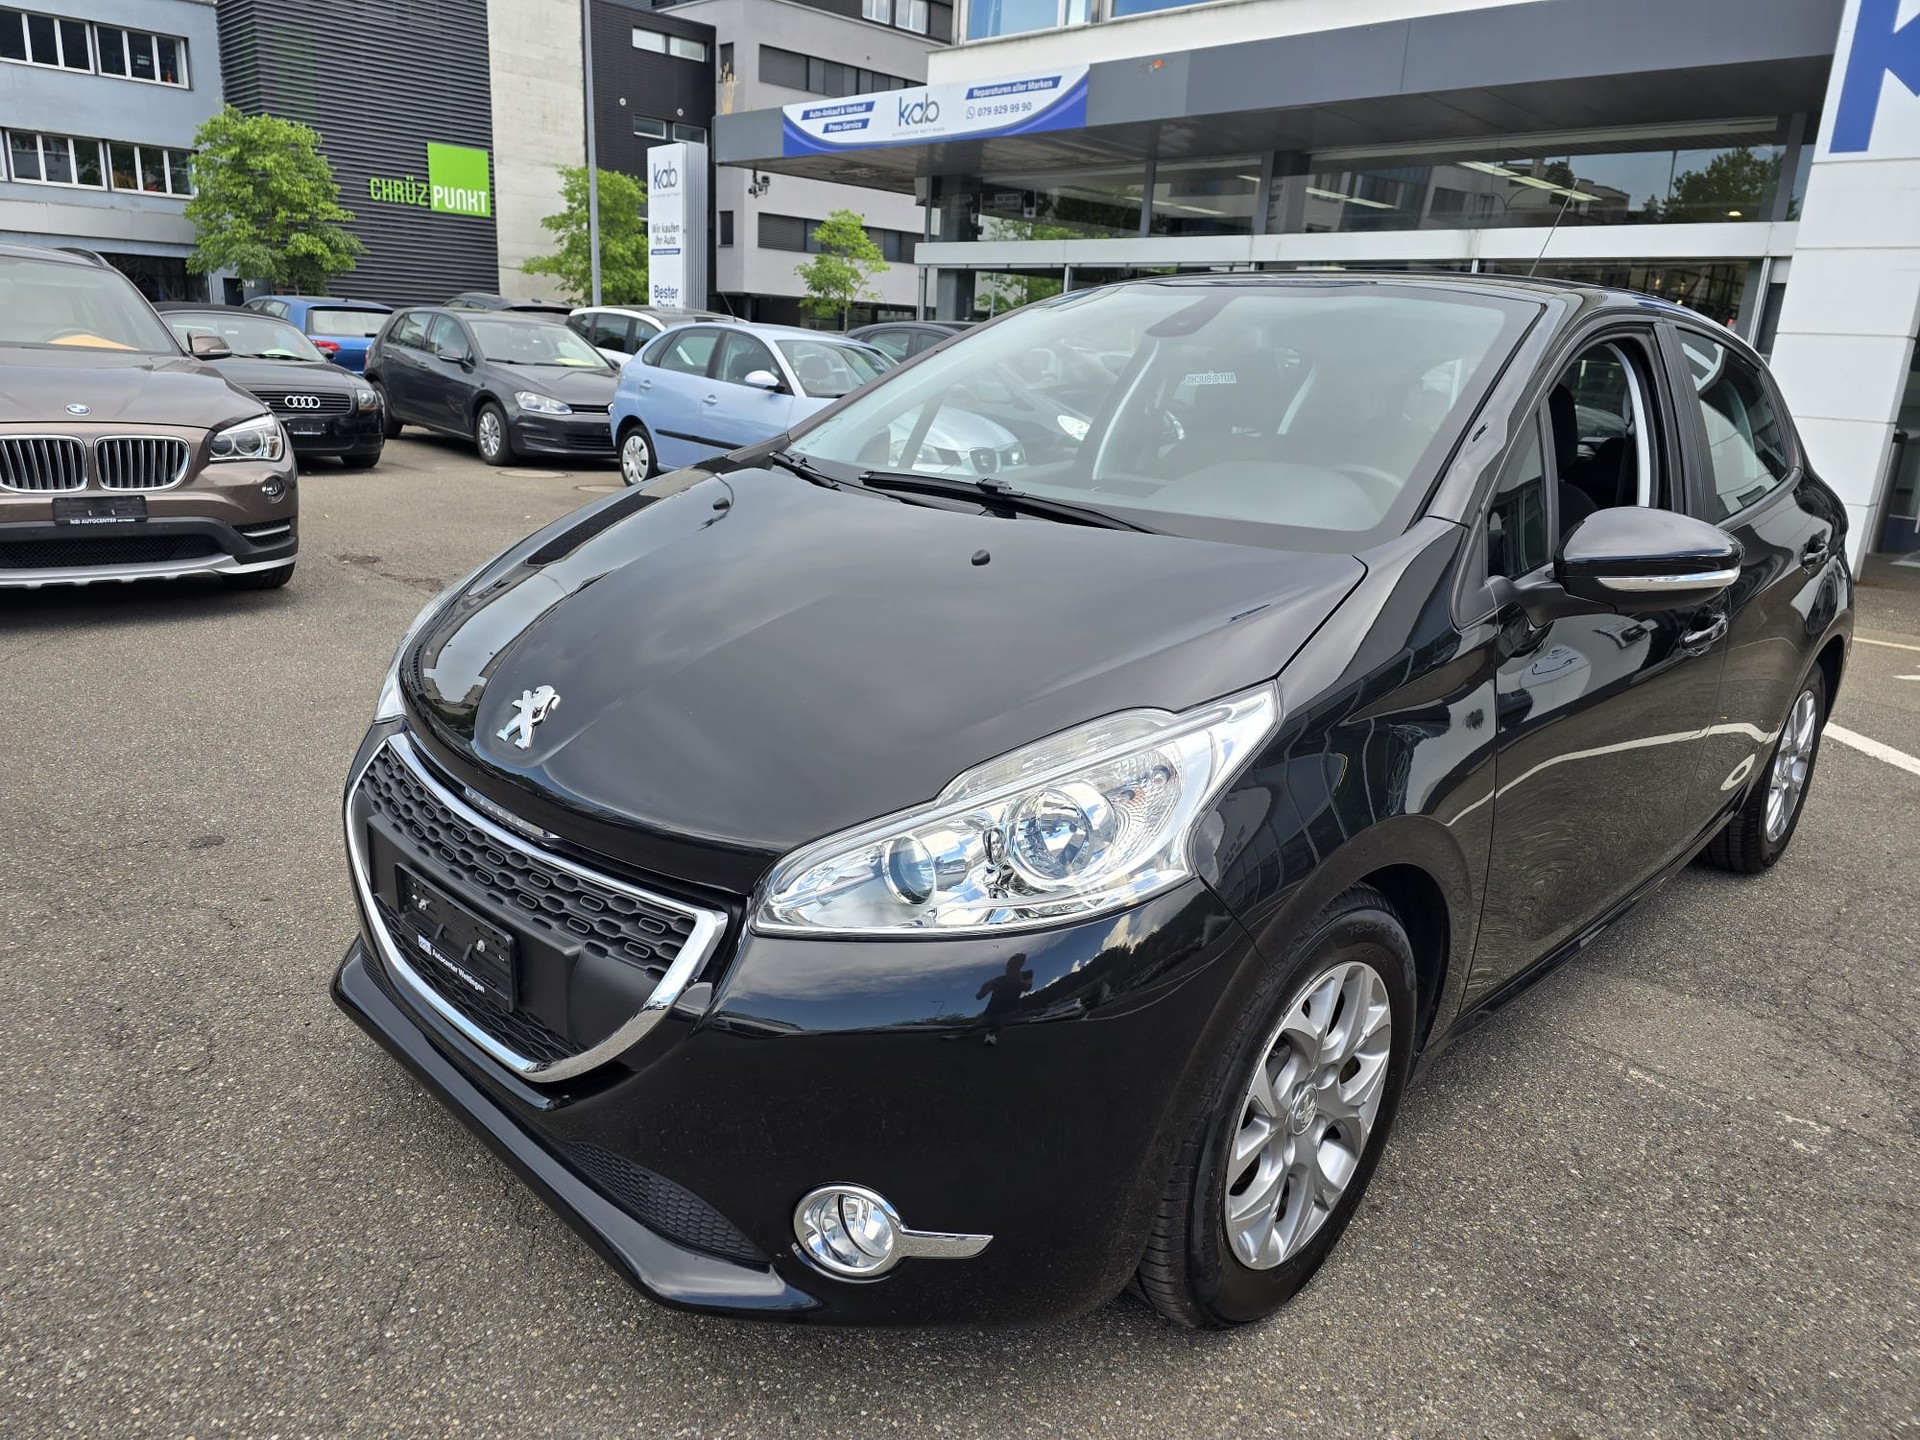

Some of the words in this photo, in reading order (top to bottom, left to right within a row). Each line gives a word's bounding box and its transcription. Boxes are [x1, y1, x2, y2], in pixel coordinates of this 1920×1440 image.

[972, 85, 1011, 98] Reparaturen
[1012, 82, 1027, 93] aller
[1028, 79, 1053, 90] Marken
[808, 106, 840, 118] Auto-Ankauf
[845, 103, 866, 113] Verkauf
[898, 92, 940, 127] kab
[977, 106, 992, 117] 079
[993, 104, 1008, 115] 929
[1010, 103, 1020, 113] 99
[1021, 101, 1032, 112] 90
[828, 121, 862, 132] Pneu-Service
[653, 161, 678, 190] kab
[369, 175, 429, 206] CHRÜZ
[432, 185, 487, 213] PUNKT
[653, 224, 661, 233] Wir
[661, 222, 680, 233] kaufen
[664, 234, 676, 244] Auto
[654, 284, 678, 299] Bester
[432, 948, 458, 973] Autocenter
